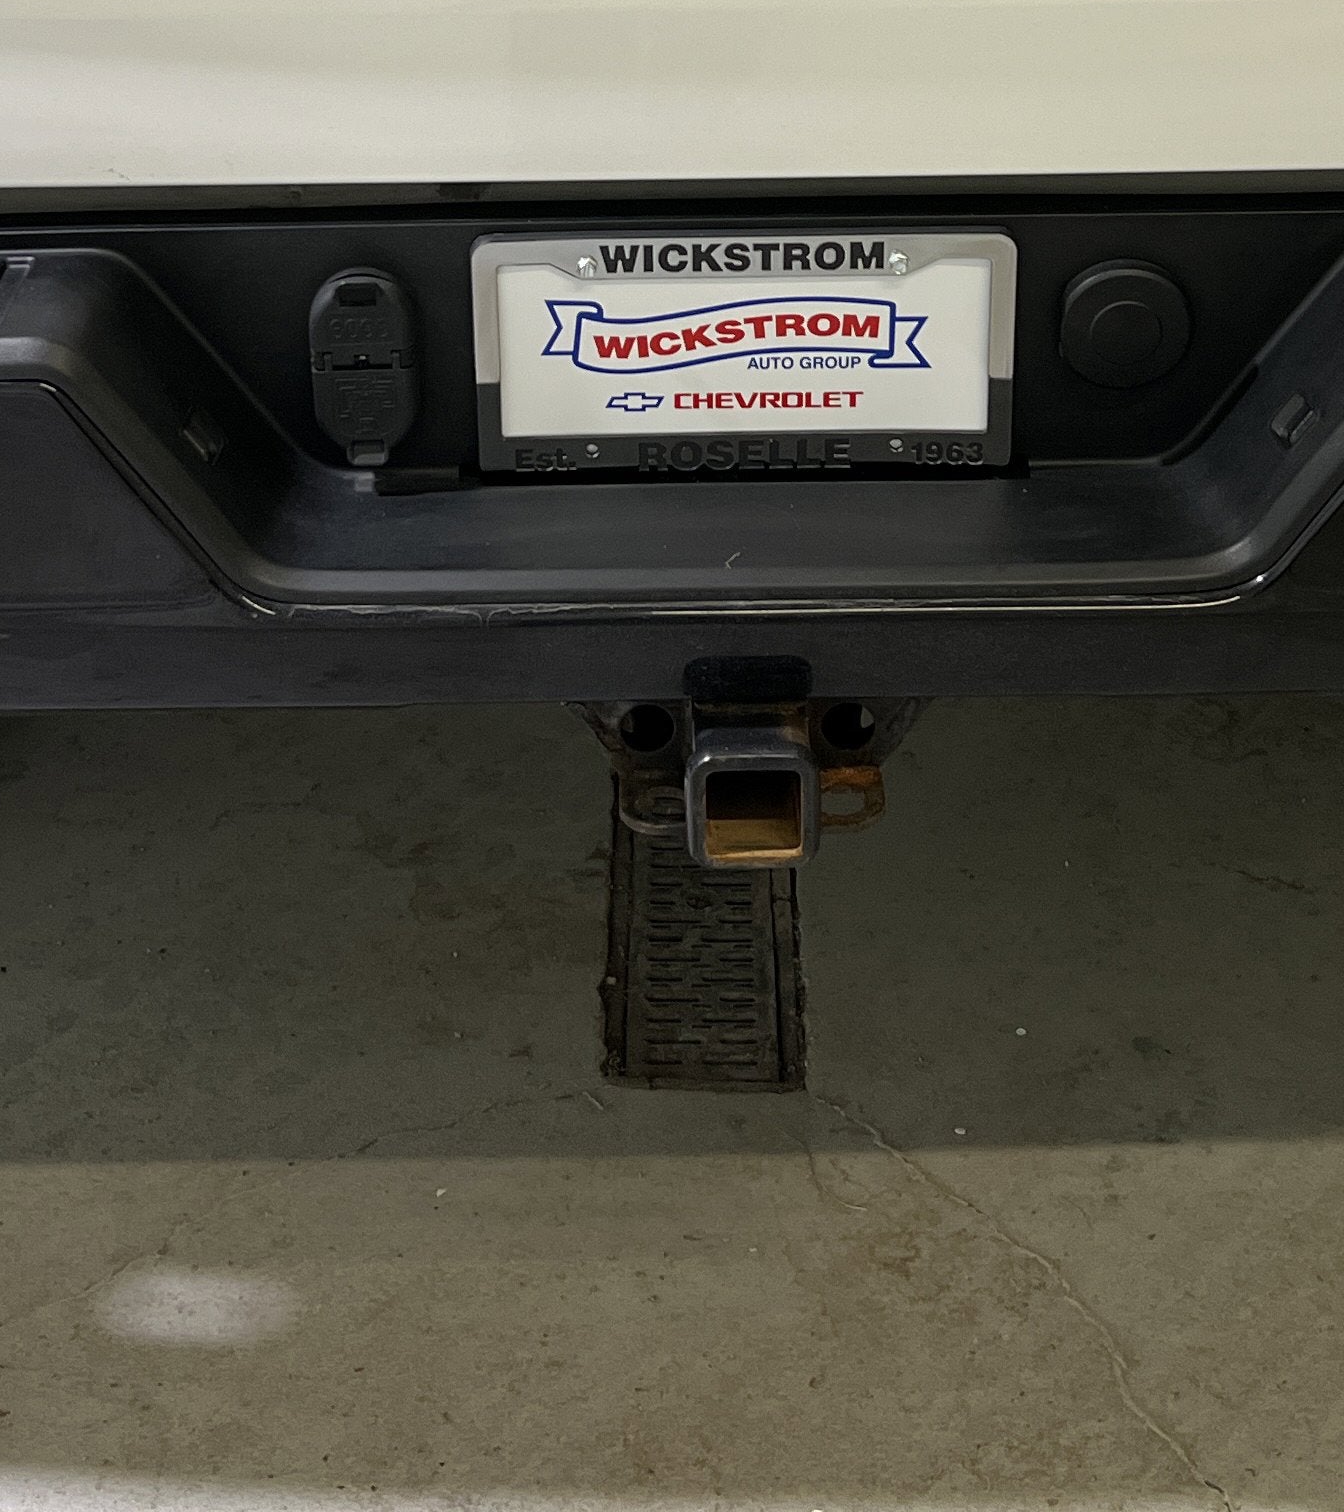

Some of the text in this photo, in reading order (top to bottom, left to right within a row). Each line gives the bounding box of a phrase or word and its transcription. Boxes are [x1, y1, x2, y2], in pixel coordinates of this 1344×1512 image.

[599, 241, 886, 274] WICKSTROM
[593, 312, 880, 359] WICKSTROM
[747, 355, 862, 370] AUTO GROUP
[673, 391, 864, 409] CHEVROLET
[515, 438, 985, 472] Est. ROSELLE 1963
